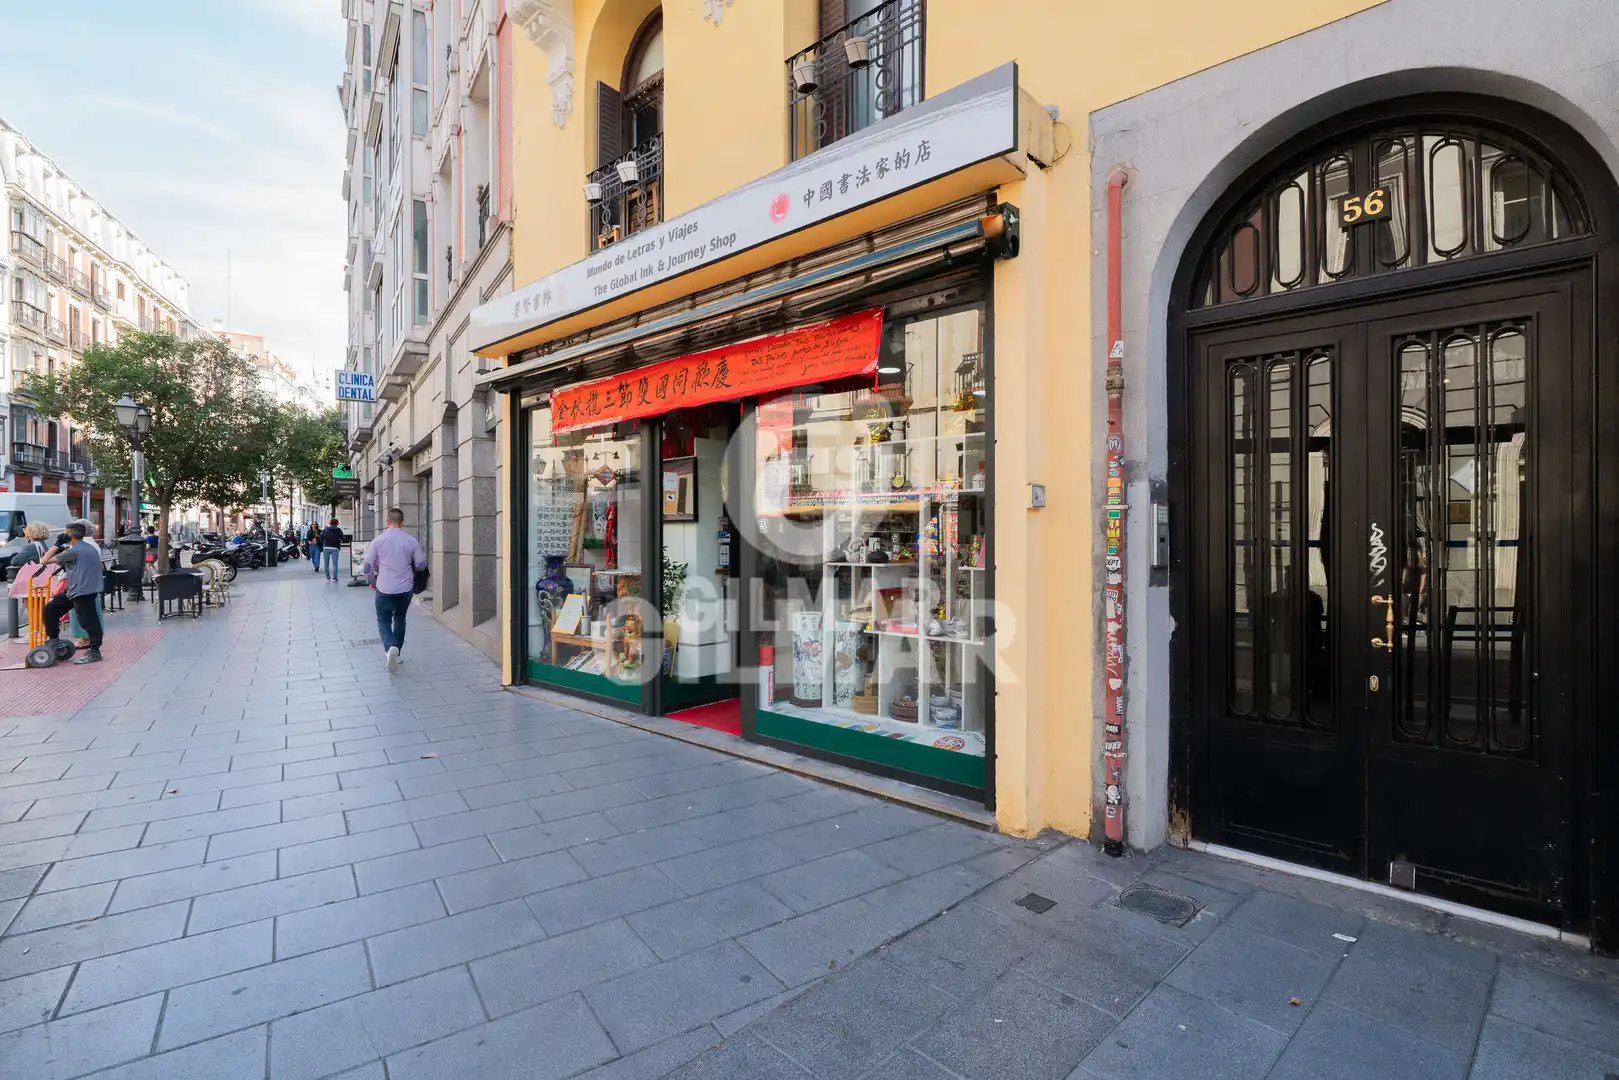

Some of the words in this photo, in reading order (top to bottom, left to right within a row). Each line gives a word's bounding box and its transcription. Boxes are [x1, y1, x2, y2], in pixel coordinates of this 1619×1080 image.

[803, 139, 932, 208] 中國書法家的店
[1343, 189, 1384, 222] 56
[586, 259, 613, 279] Mundo
[615, 254, 625, 266] de
[627, 240, 656, 260] Letras
[658, 236, 665, 250] y
[668, 221, 699, 243] Viajes
[593, 283, 608, 297] The
[610, 270, 637, 291] Global
[640, 264, 654, 279] Ink
[657, 259, 665, 272] &
[667, 244, 706, 271] Journey
[709, 232, 736, 252] Shop
[338, 373, 375, 387] CLINICA
[338, 386, 375, 400] DENTAL
